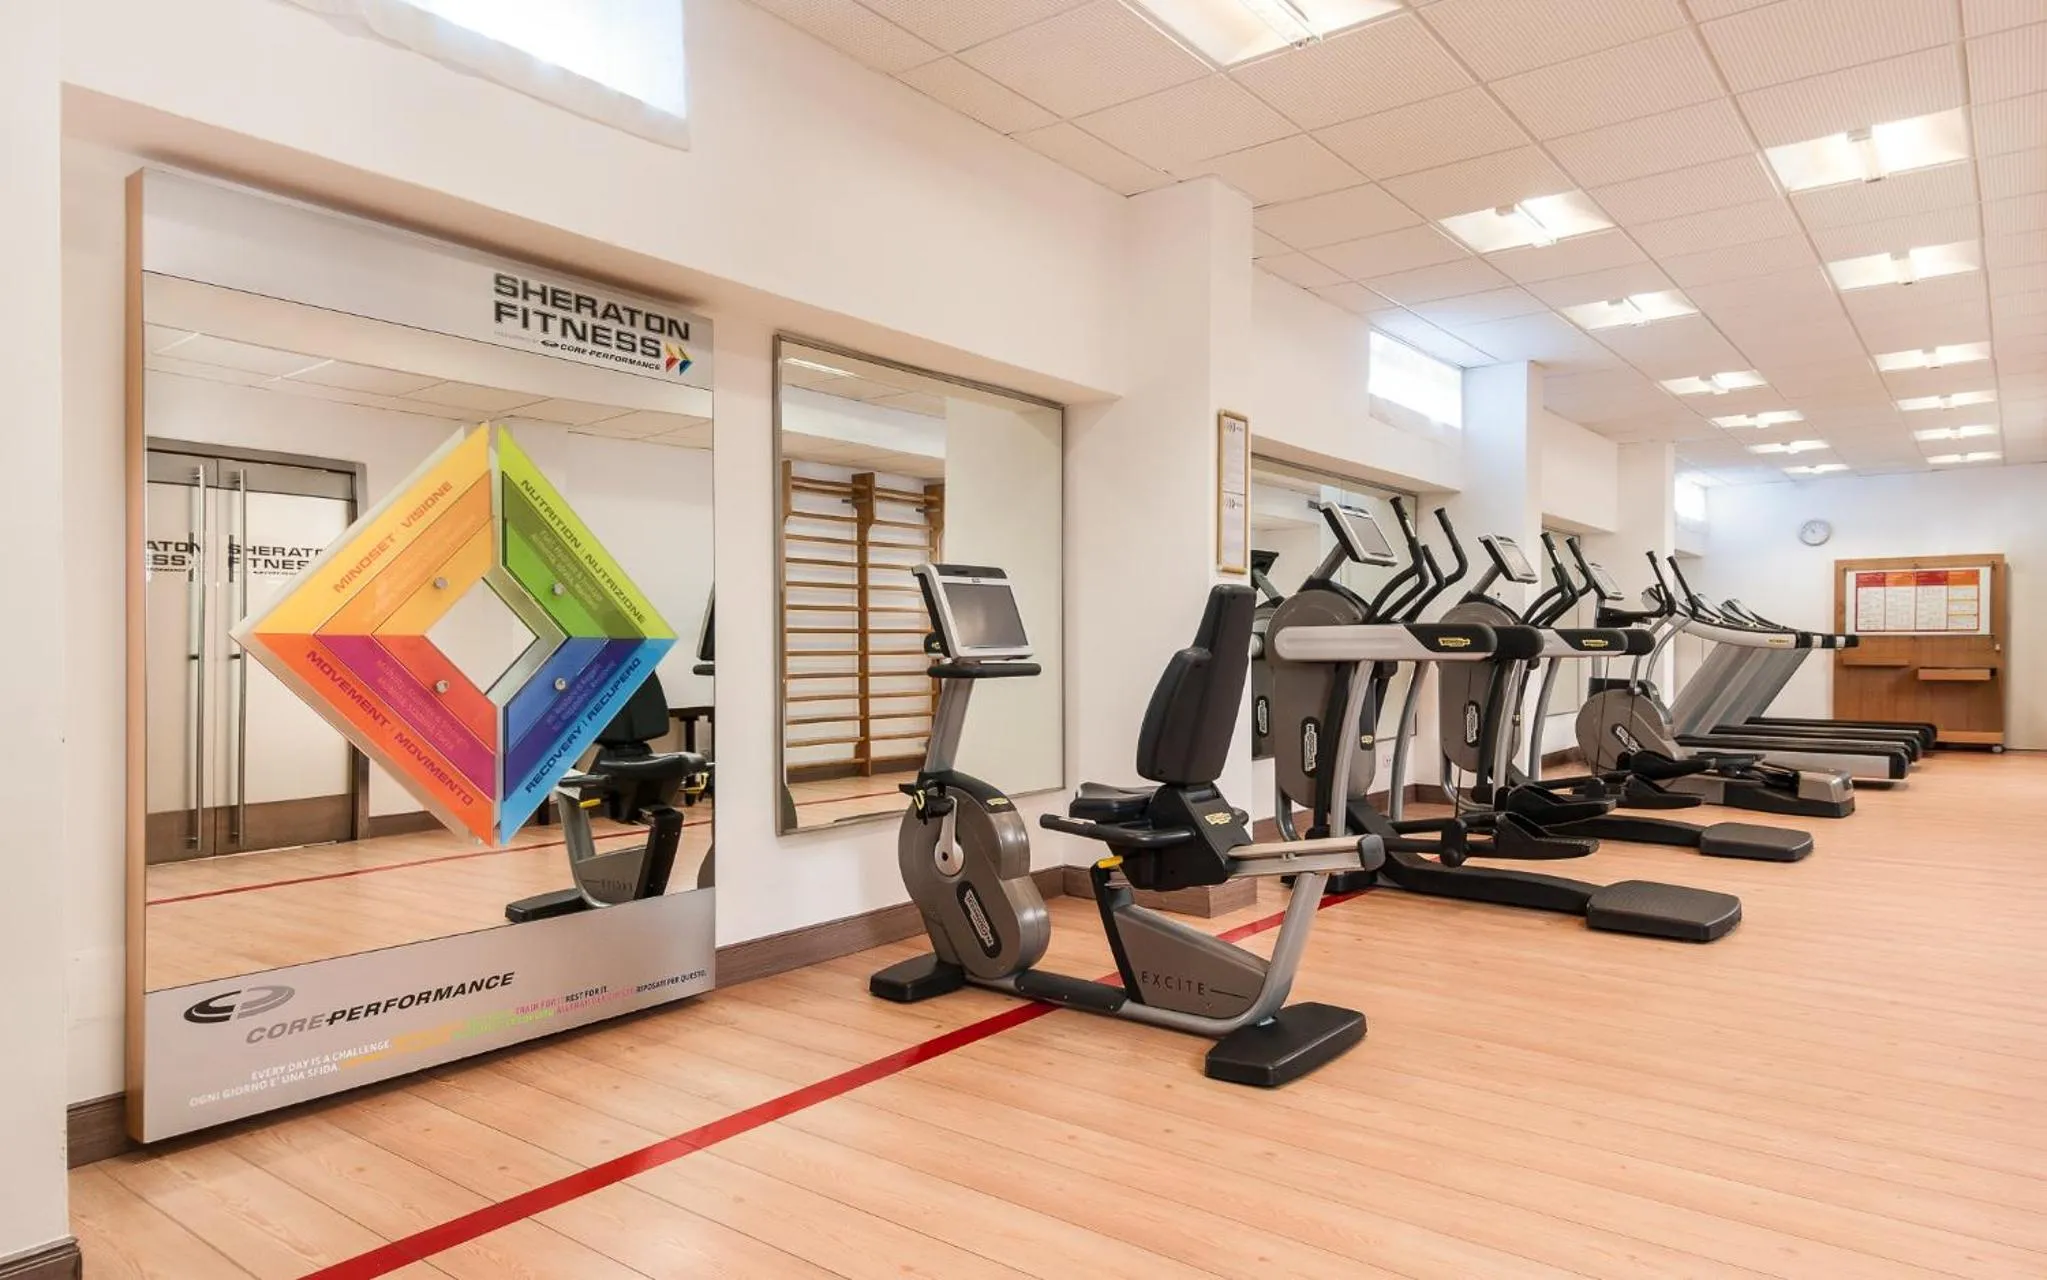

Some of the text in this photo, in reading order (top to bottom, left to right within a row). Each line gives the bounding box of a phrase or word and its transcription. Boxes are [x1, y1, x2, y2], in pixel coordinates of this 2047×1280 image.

[493, 272, 690, 341] SHERATON
[494, 300, 661, 359] FITNESS
[333, 534, 396, 593] MINDSET
[400, 481, 453, 528] VISIONE
[520, 479, 581, 548] NUTRITION
[585, 553, 647, 624] NUTRIZIONE
[306, 650, 391, 727] MOVEMENT
[394, 732, 474, 806] MOVIMENTO
[525, 725, 583, 794] RECOVERY
[588, 657, 641, 721] RECUPERO
[1141, 970, 1205, 996] EXCITE
[251, 1064, 286, 1081] EVERY
[288, 1058, 310, 1073] DAY
[311, 1056, 322, 1066] IS
[323, 1054, 331, 1063] A
[584, 987, 599, 998] FOR
[188, 1091, 220, 1107] OGNI
[222, 1079, 268, 1099] GIORNO
[281, 1070, 305, 1085] UNA
